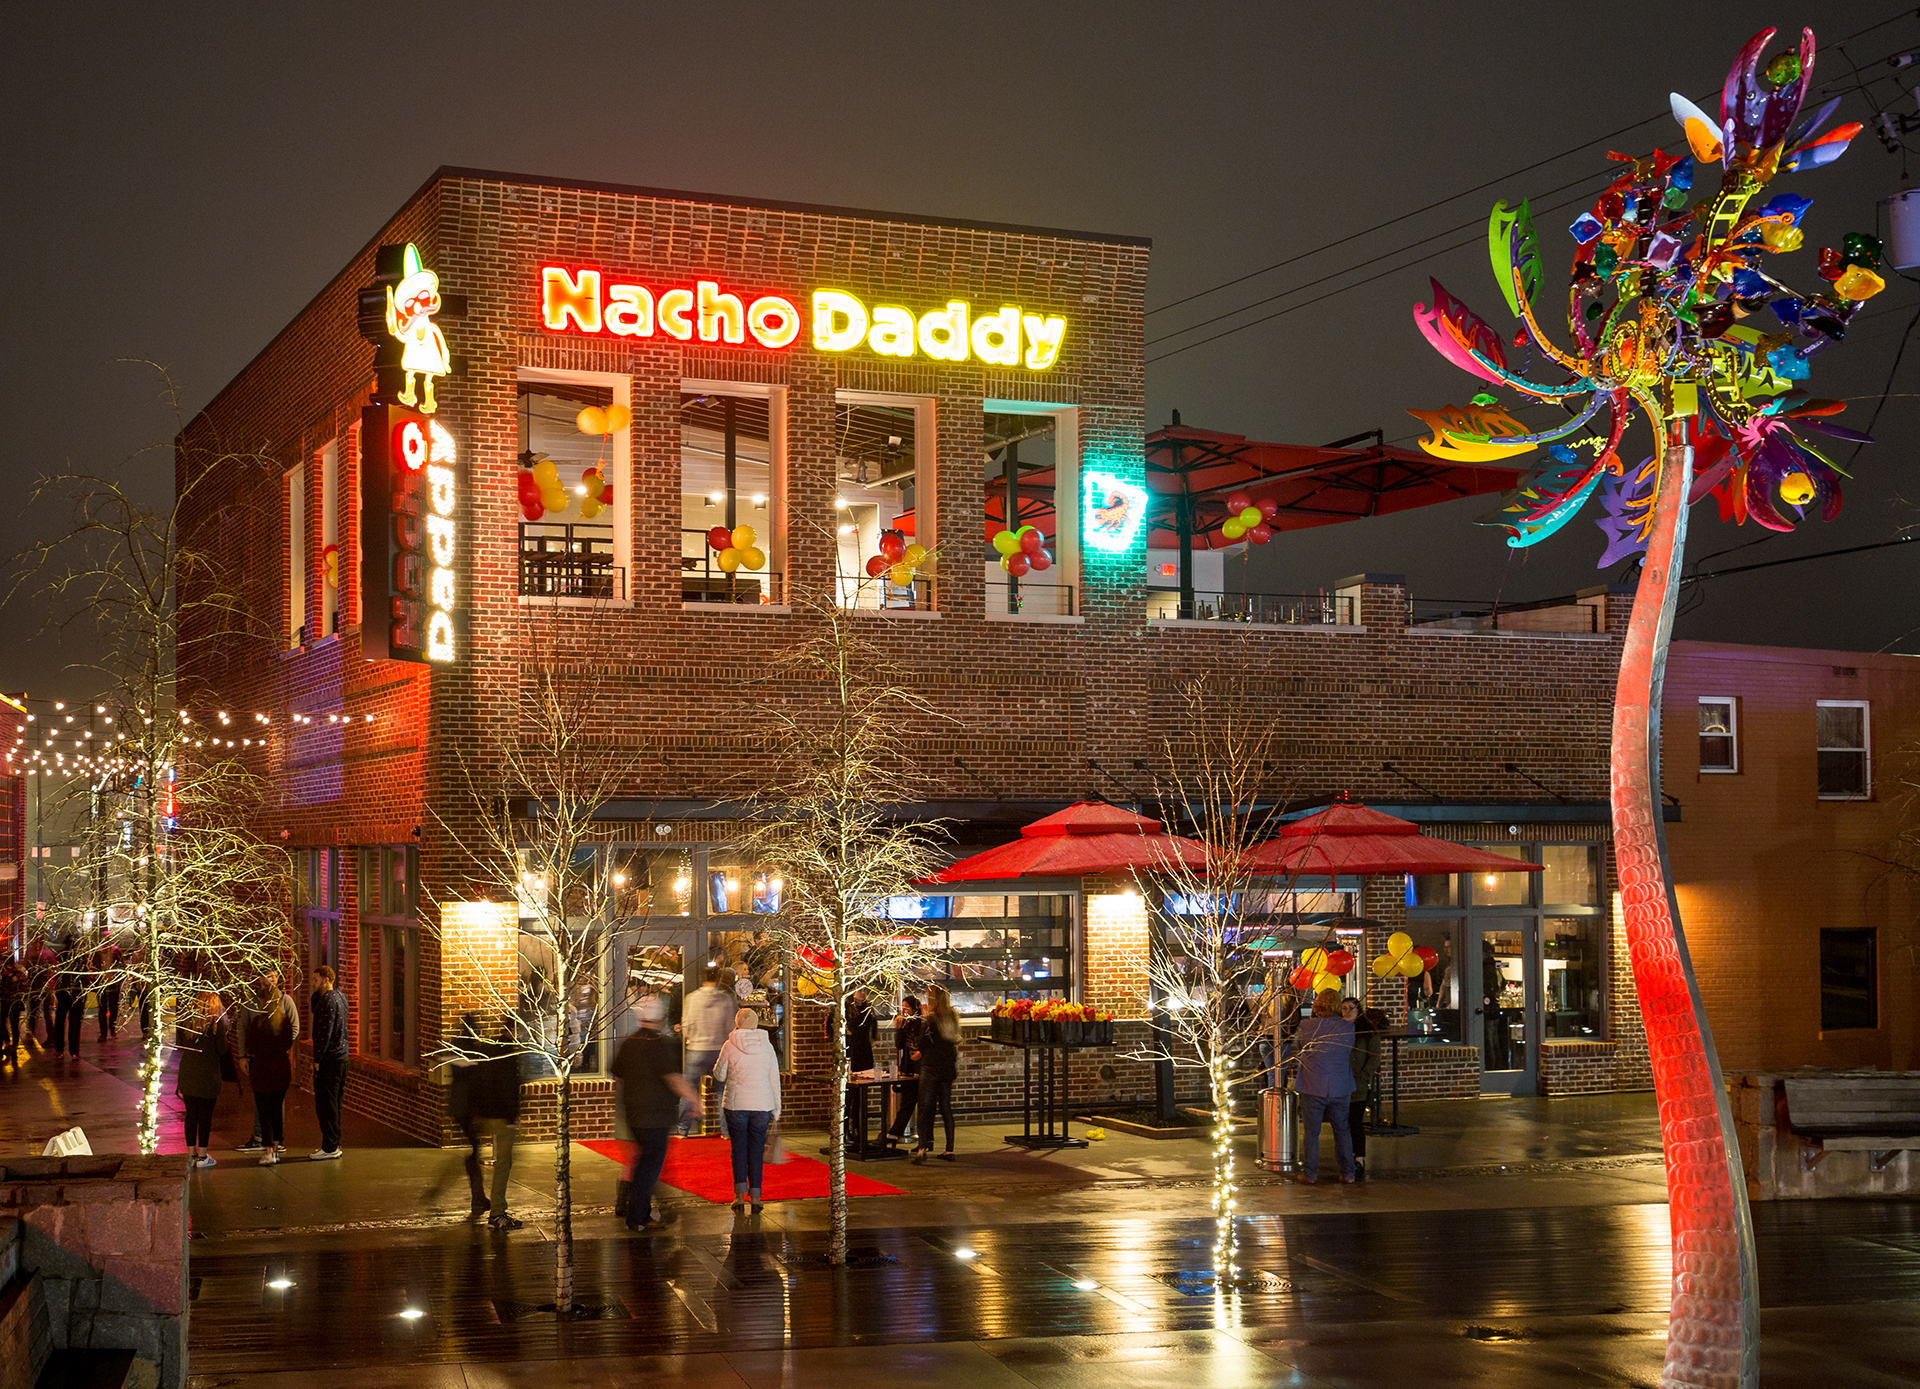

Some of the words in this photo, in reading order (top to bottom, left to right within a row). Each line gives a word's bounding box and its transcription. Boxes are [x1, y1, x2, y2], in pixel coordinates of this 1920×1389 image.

[541, 266, 801, 349] Nacho
[811, 288, 1068, 370] Daddy
[425, 419, 457, 663] Daddy
